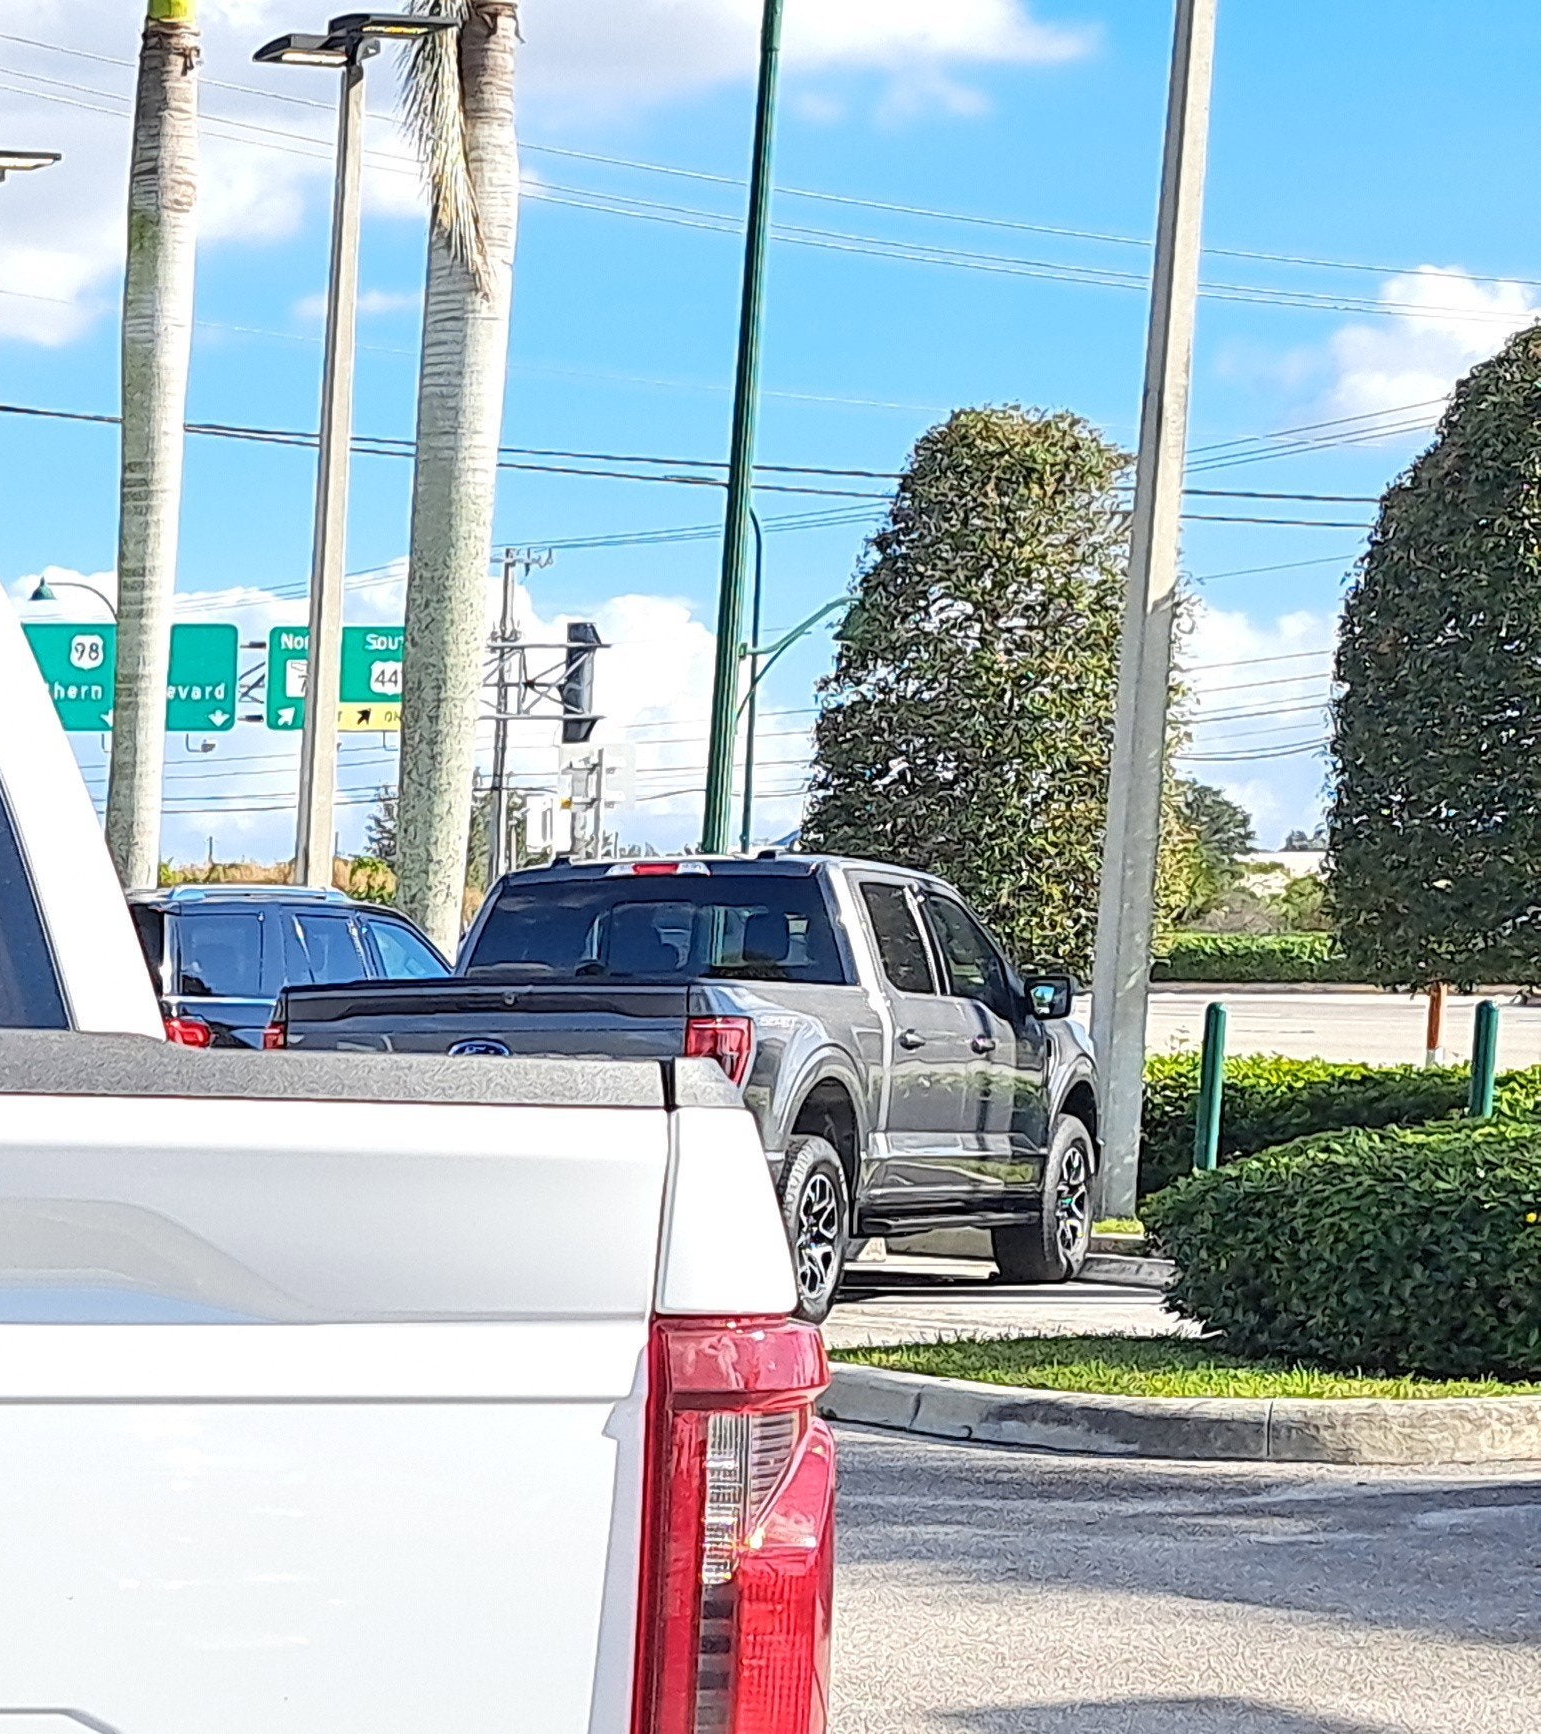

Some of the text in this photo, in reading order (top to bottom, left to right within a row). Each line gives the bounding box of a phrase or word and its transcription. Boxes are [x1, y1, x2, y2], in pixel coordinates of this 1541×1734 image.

[75, 642, 100, 661] 98
[374, 669, 404, 687] 44
[53, 681, 226, 700] hern evard
